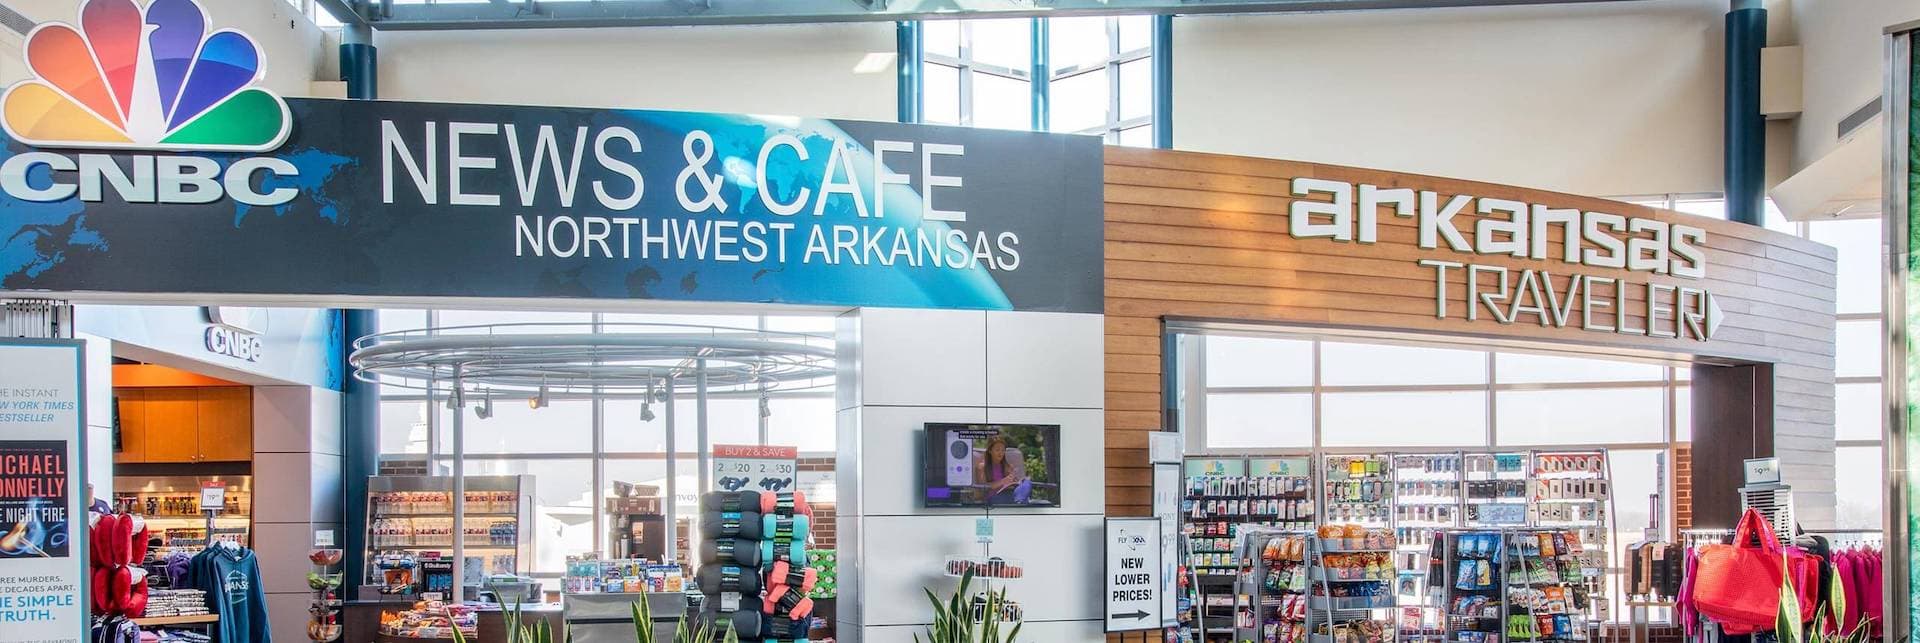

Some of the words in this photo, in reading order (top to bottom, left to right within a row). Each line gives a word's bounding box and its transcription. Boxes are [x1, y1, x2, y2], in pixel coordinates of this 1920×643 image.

[381, 120, 645, 211] NEWS
[675, 129, 728, 214] &
[756, 133, 967, 222] CAFE
[0, 152, 300, 206] CNBC
[1290, 176, 1706, 279] arkansas
[515, 215, 794, 263] NORTHWEST
[803, 224, 1021, 271] ARKANSAS
[1418, 259, 1710, 342] TRAVELER
[204, 326, 264, 362] CNBC
[12, 388, 59, 398] INSTANT
[13, 401, 40, 410] YORK
[44, 401, 74, 410] TIMES
[0, 413, 55, 422] ESTSELLER
[725, 448, 743, 456] BUY
[746, 448, 752, 456] 2
[763, 448, 786, 457] SAVE
[0, 454, 65, 475] ICHAEL
[718, 463, 724, 472] 2
[760, 464, 766, 473] 2
[6, 507, 39, 523] NIGHT
[42, 507, 65, 522] FIRE
[1121, 557, 1144, 569] NEW
[18, 575, 63, 583] MURDERS.
[1115, 574, 1150, 586] LOWER
[46, 584, 76, 592] APART.
[17, 594, 73, 608] SIMPLE
[1113, 589, 1152, 602] PRICES!
